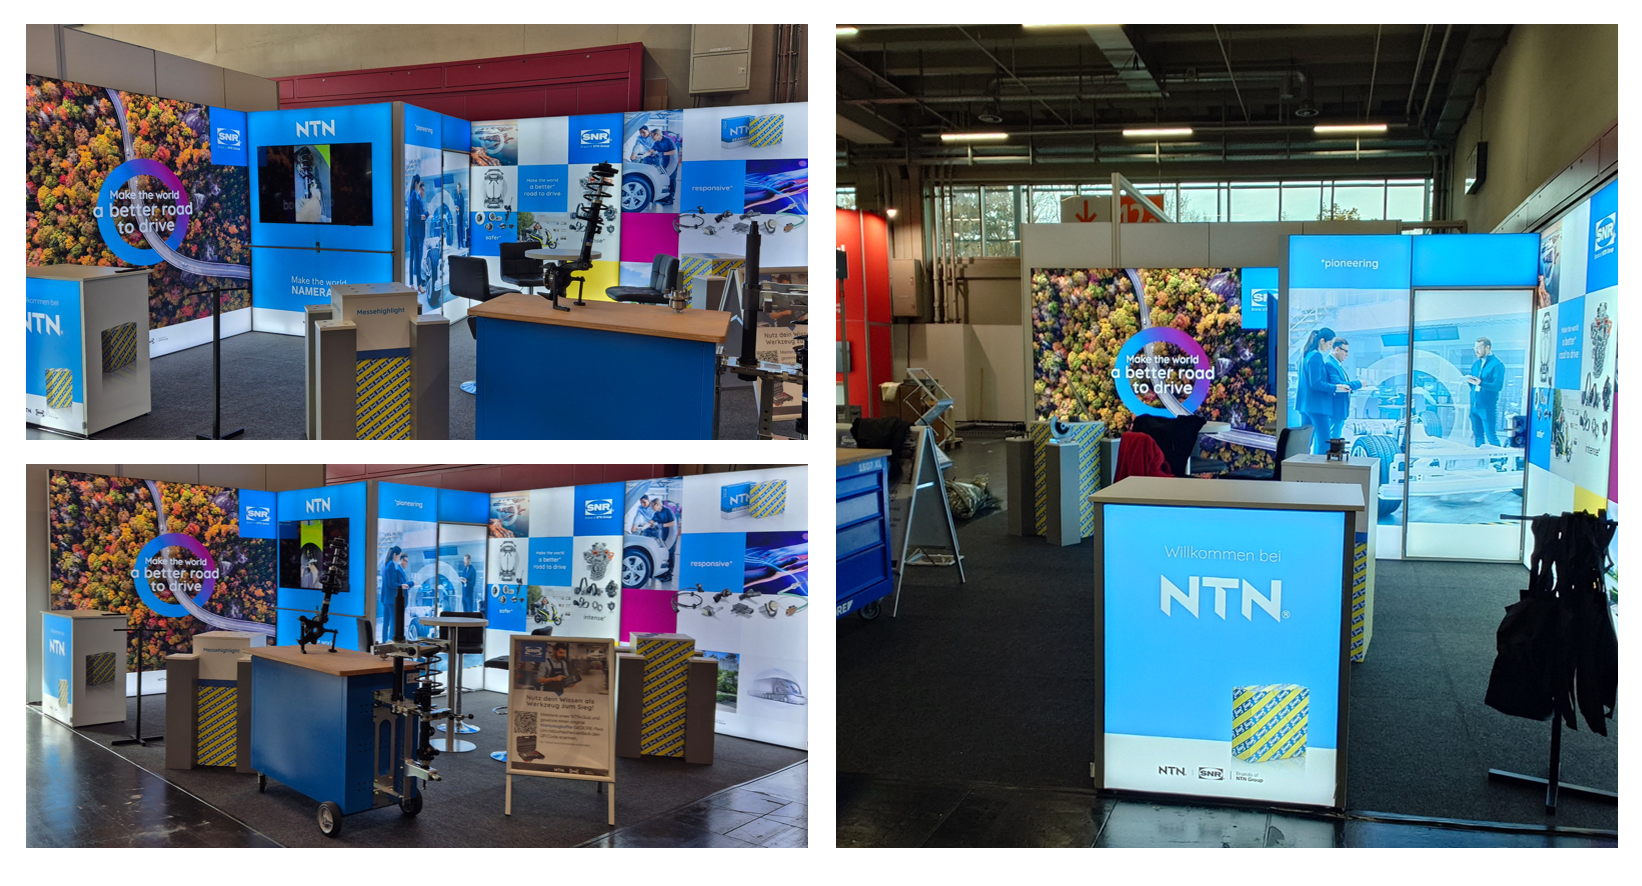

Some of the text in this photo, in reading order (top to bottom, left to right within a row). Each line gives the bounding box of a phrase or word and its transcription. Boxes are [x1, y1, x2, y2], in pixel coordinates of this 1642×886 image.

[296, 120, 335, 137] NTN
[218, 132, 239, 141] SNR
[110, 190, 179, 199] Make the world
[93, 202, 192, 218] a better road
[118, 218, 175, 234] to drive
[292, 276, 310, 284] Make
[357, 307, 405, 316] Messehighlight
[1126, 355, 1199, 364] Make the world
[1111, 366, 1215, 379] a better road
[1133, 381, 1193, 394] to drive
[306, 497, 330, 513] NTN
[1165, 545, 1282, 563] Willkommen bei
[131, 567, 219, 579] a better road
[150, 580, 202, 591] to drive
[50, 639, 66, 657] NTN
